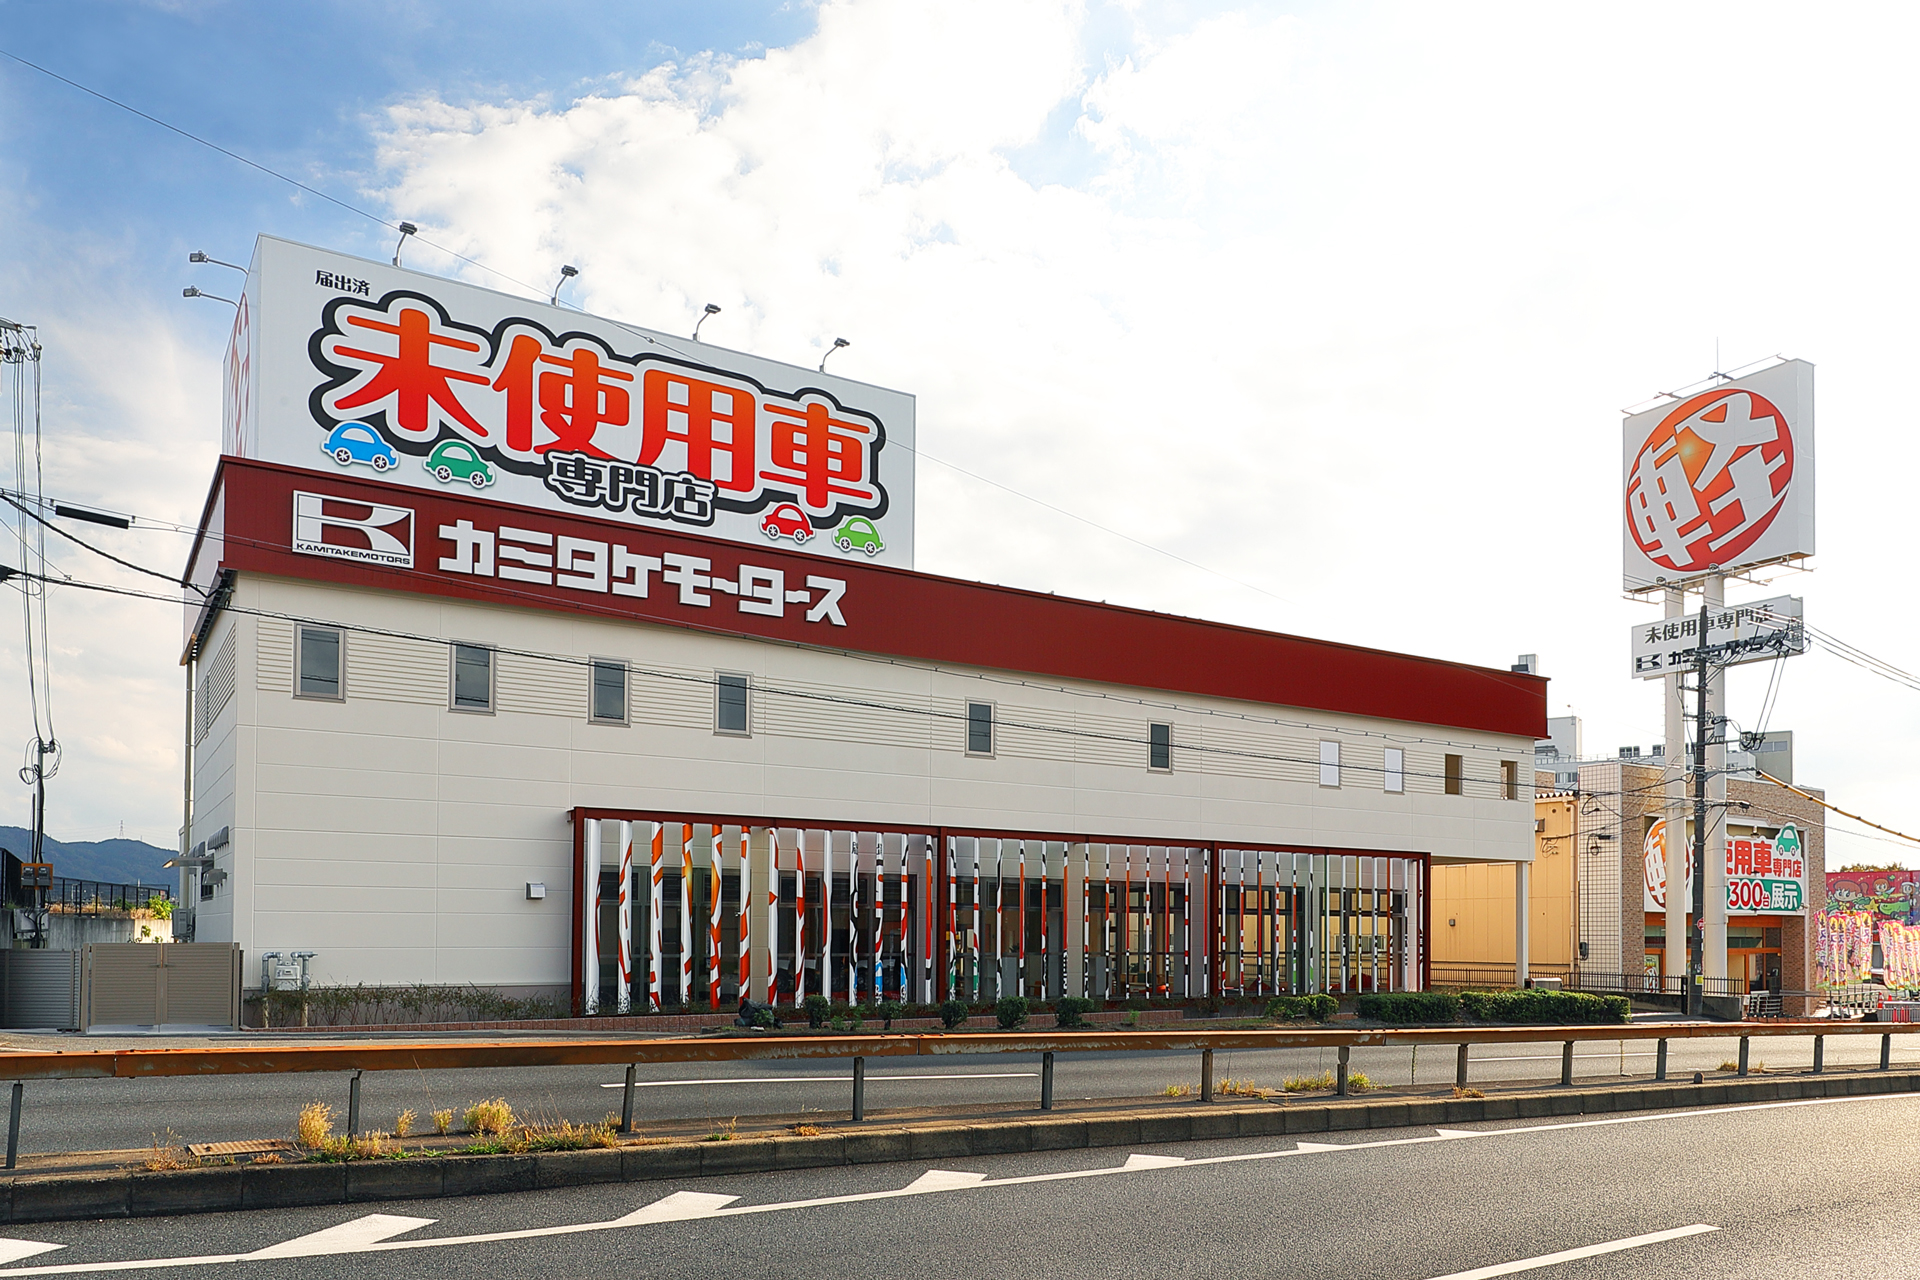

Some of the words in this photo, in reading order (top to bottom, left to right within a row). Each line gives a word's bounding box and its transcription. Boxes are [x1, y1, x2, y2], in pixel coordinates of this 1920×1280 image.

[314, 269, 371, 297] 届出済
[331, 305, 875, 509] 未使用車
[549, 455, 714, 519] 専門店
[1629, 392, 1792, 567] 軽
[296, 542, 411, 566] KAMITAKEMOTORS
[438, 518, 847, 627] カミタケモータース
[1773, 857, 1802, 878] 専門店
